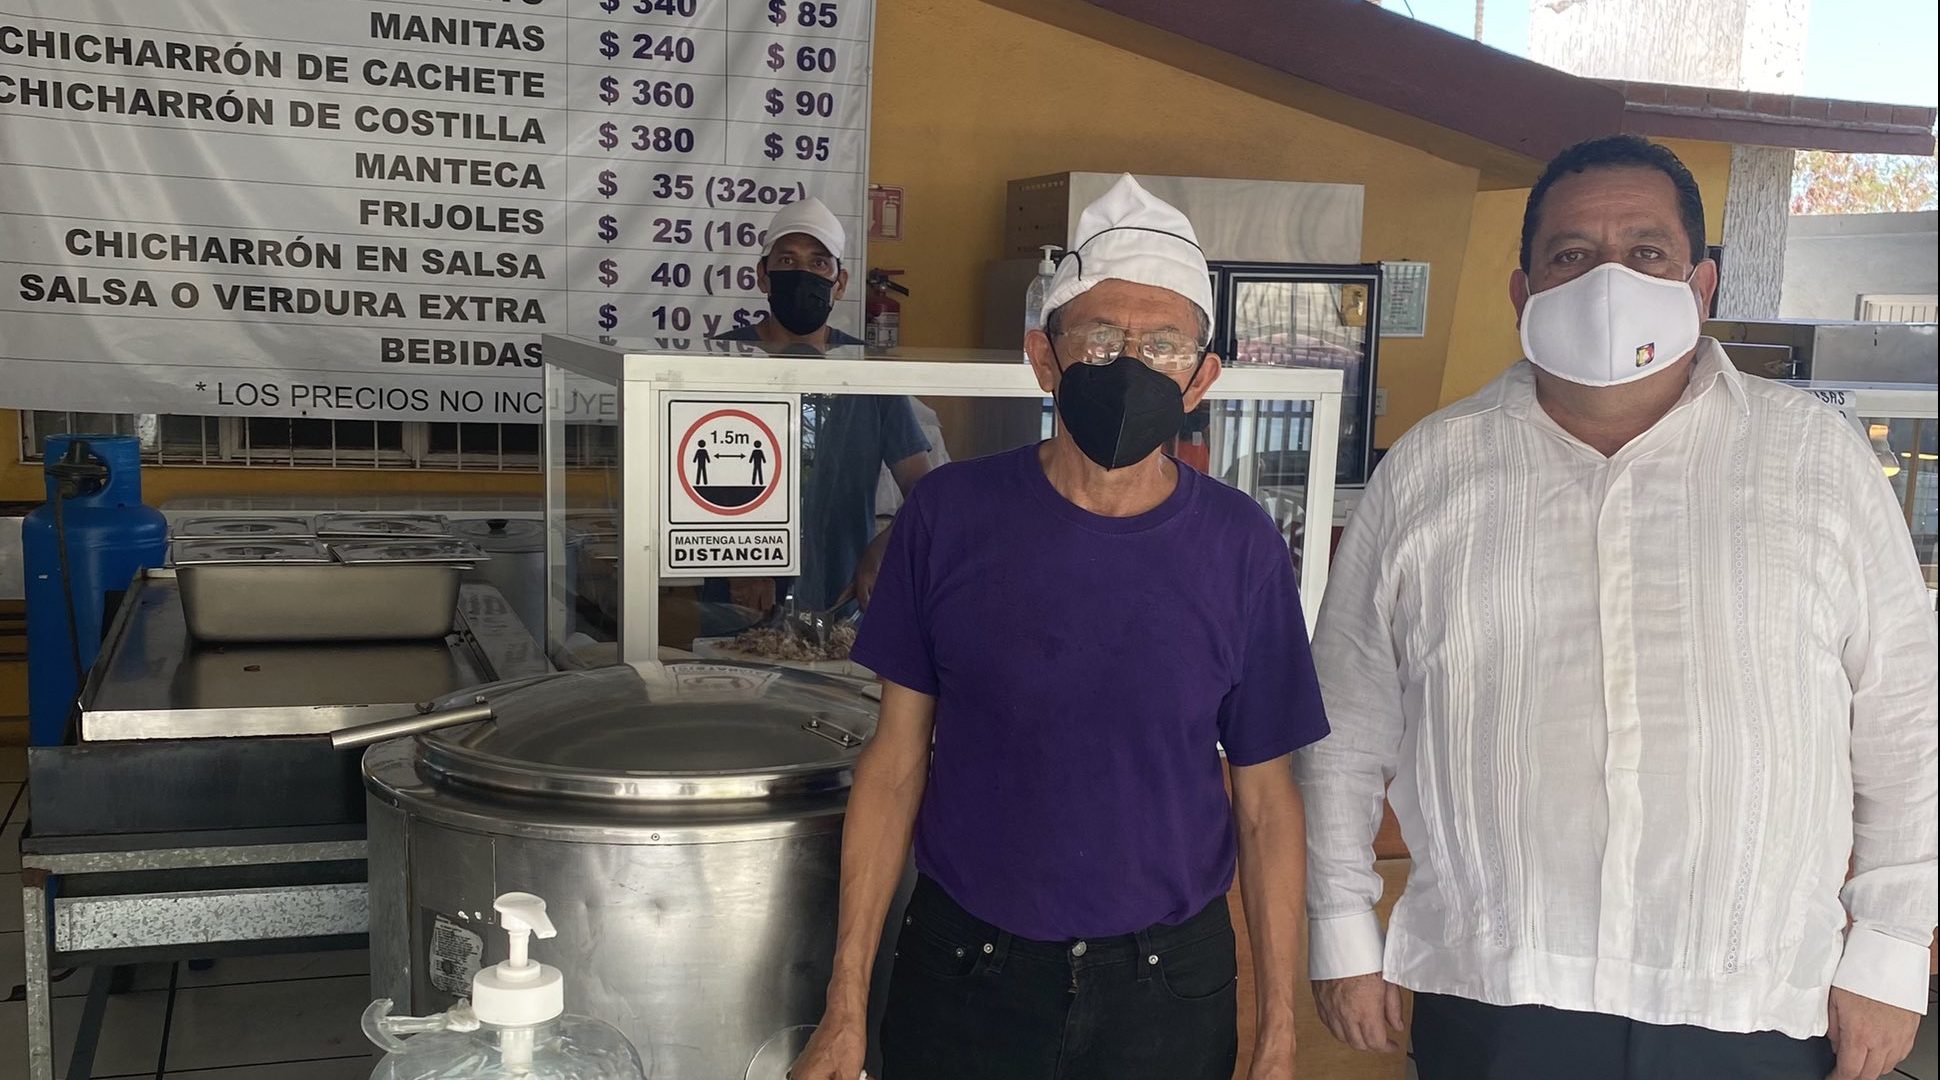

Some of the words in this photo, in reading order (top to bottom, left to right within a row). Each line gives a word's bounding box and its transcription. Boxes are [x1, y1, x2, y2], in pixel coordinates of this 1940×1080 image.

[768, 0, 786, 26] $
[797, 2, 838, 28] 85
[371, 12, 545, 51] MANITAS
[600, 30, 619, 60] $
[633, 34, 694, 63] 240
[767, 43, 784, 72] $
[797, 46, 837, 72] 60
[0, 26, 281, 78] CHICHARRÓN
[298, 54, 348, 83] DE
[363, 59, 545, 98] CACHETE
[599, 76, 619, 106] $
[632, 80, 694, 108] 360
[765, 88, 784, 117] $
[796, 91, 834, 117] 90
[0, 75, 273, 125] CHICHARRÓN
[290, 101, 340, 129] DE
[355, 106, 546, 144] COSTILLA
[599, 121, 618, 151] $
[632, 126, 694, 153] 380
[764, 132, 783, 161] $
[796, 136, 830, 161] 95
[356, 153, 546, 189] MANTECA
[598, 170, 617, 199] $
[652, 174, 694, 199] 35
[706, 176, 806, 208] (32oz)
[360, 200, 545, 234] FRIJOLES
[598, 215, 618, 243] $
[653, 218, 692, 244] 25
[66, 229, 341, 269] CHICHARRÓN
[357, 246, 407, 272] EN
[422, 249, 546, 279] SALSA
[599, 259, 618, 288] $
[651, 263, 691, 287] 40
[704, 265, 755, 296] (16
[20, 274, 157, 307] SALSA
[171, 282, 199, 308] O
[213, 284, 406, 318] VERDURA
[420, 294, 546, 323] EXTRA
[598, 303, 617, 331] $
[652, 306, 691, 331] 10
[703, 314, 722, 337] y
[732, 307, 770, 331] $2
[382, 338, 543, 367] BEBIDAS
[218, 383, 279, 406] LOS
[292, 385, 428, 411] PRECIOS
[441, 391, 483, 412] NO
[711, 431, 749, 444] 1.5m
[675, 536, 735, 545] MANTENGA
[738, 536, 752, 545] LA
[754, 536, 783, 545] SANA
[675, 548, 784, 561] DISTANCIA
